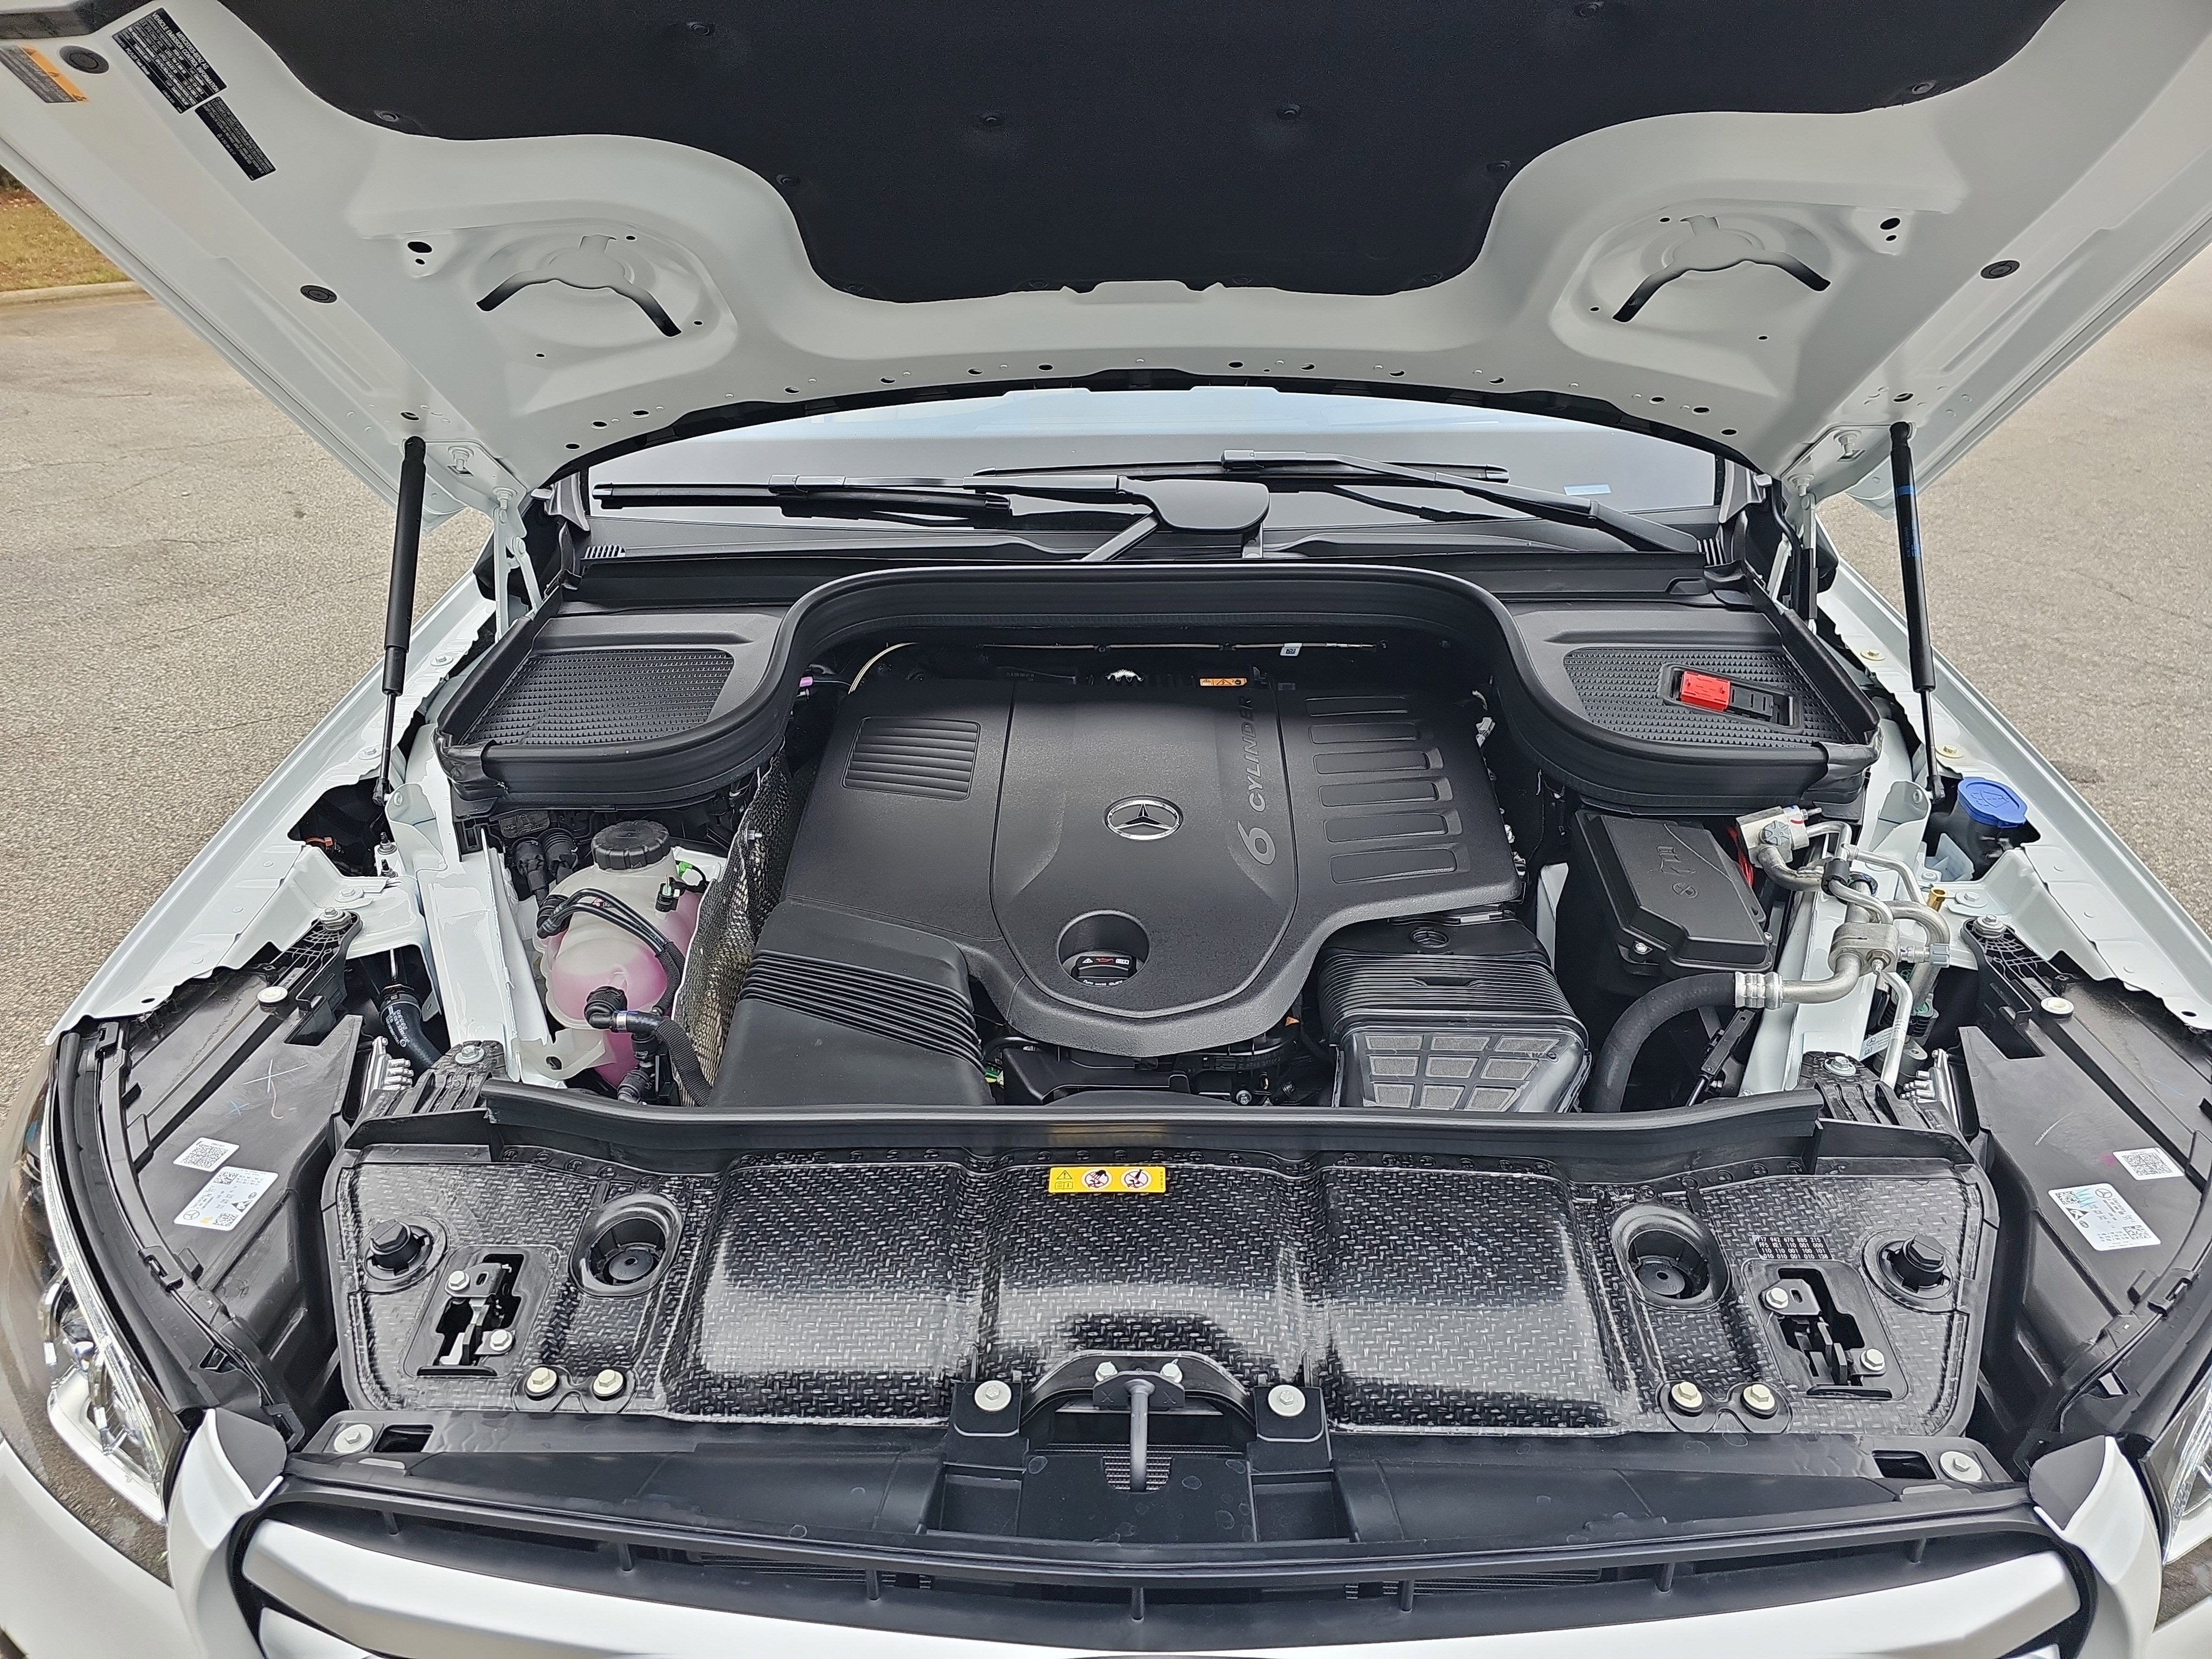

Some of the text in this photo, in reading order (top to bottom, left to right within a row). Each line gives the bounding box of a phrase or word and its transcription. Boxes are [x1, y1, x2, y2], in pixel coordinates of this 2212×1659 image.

[150, 11, 169, 31] VEHICLE
[165, 29, 185, 50] EMISSION
[181, 48, 200, 68] CONTROL
[195, 66, 220, 92] INFORMATION
[175, 31, 205, 63] MERCEDES-BENZ
[201, 62, 210, 70] AG
[1237, 696, 1276, 865] 6 CYLINDER
